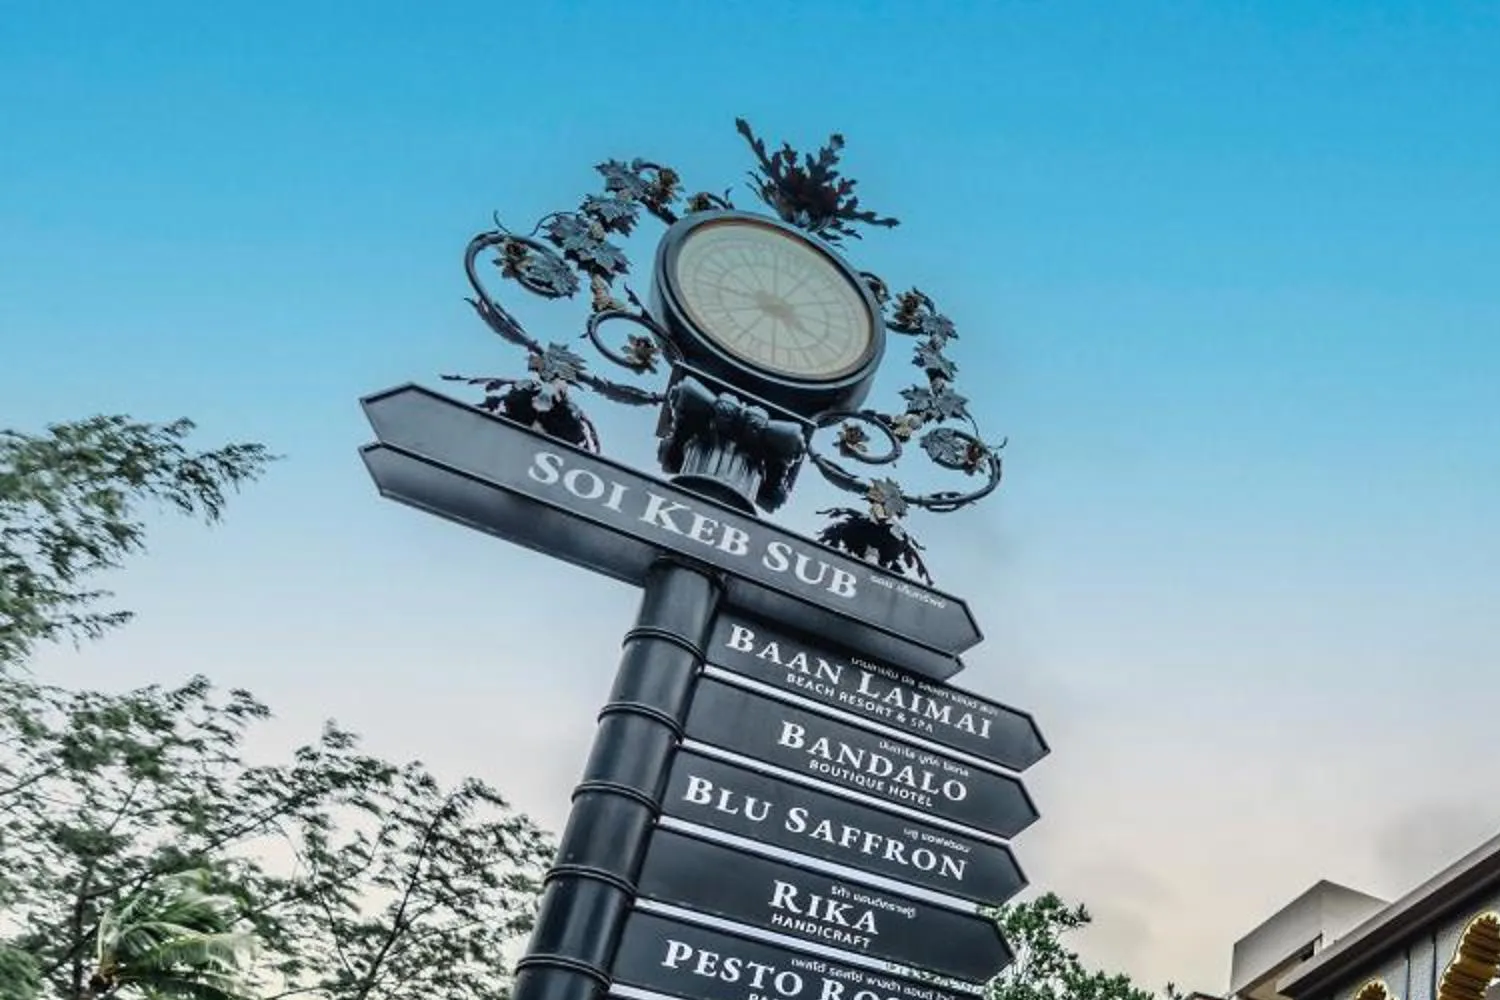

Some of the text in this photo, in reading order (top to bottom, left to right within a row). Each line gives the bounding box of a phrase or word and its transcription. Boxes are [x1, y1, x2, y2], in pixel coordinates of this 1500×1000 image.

[528, 451, 630, 513] SOI
[638, 490, 750, 556] KEB
[761, 541, 857, 598] SUB
[725, 624, 844, 685] BAAN
[856, 671, 993, 739] LAIMAI
[787, 674, 933, 733] BEACH RESORT & SPA
[777, 720, 968, 801] BANDALO
[809, 759, 885, 791] BOUTIQUE
[888, 785, 933, 807] HOTEL
[682, 775, 968, 881] BLU SAFFRON
[767, 879, 879, 935] RIKA
[771, 912, 872, 949] HANDICRAFT
[660, 939, 803, 997] PESTO
